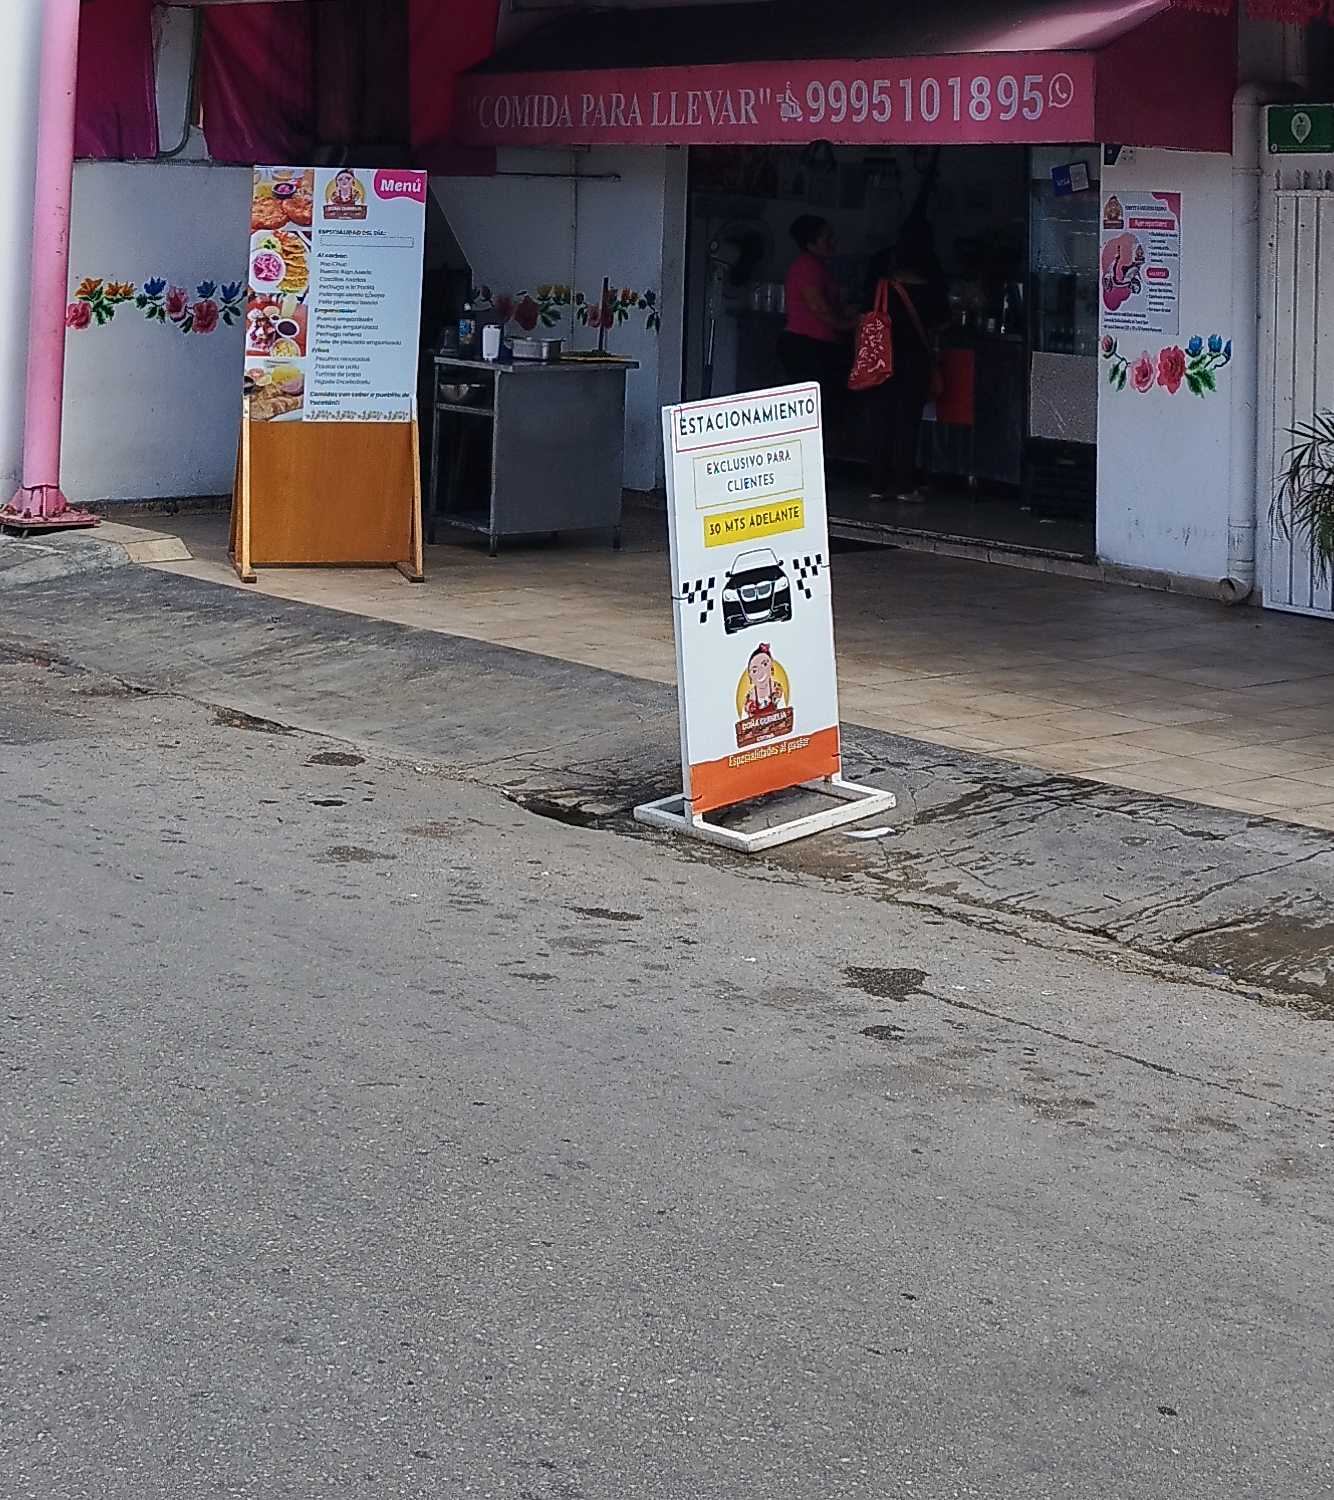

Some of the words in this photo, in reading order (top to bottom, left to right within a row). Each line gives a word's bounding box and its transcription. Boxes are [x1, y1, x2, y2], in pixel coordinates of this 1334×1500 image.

[579, 91, 644, 128] PARA
[804, 72, 1045, 125] 9995101895
[380, 178, 422, 193] Menú
[680, 398, 815, 436] ESTACIONAMIENTO
[706, 453, 764, 476] EXCLUSIVO
[767, 449, 792, 465] PARA
[727, 472, 775, 492] CLIENTES
[724, 517, 746, 533] MTS
[749, 506, 800, 529] ADELANTE
